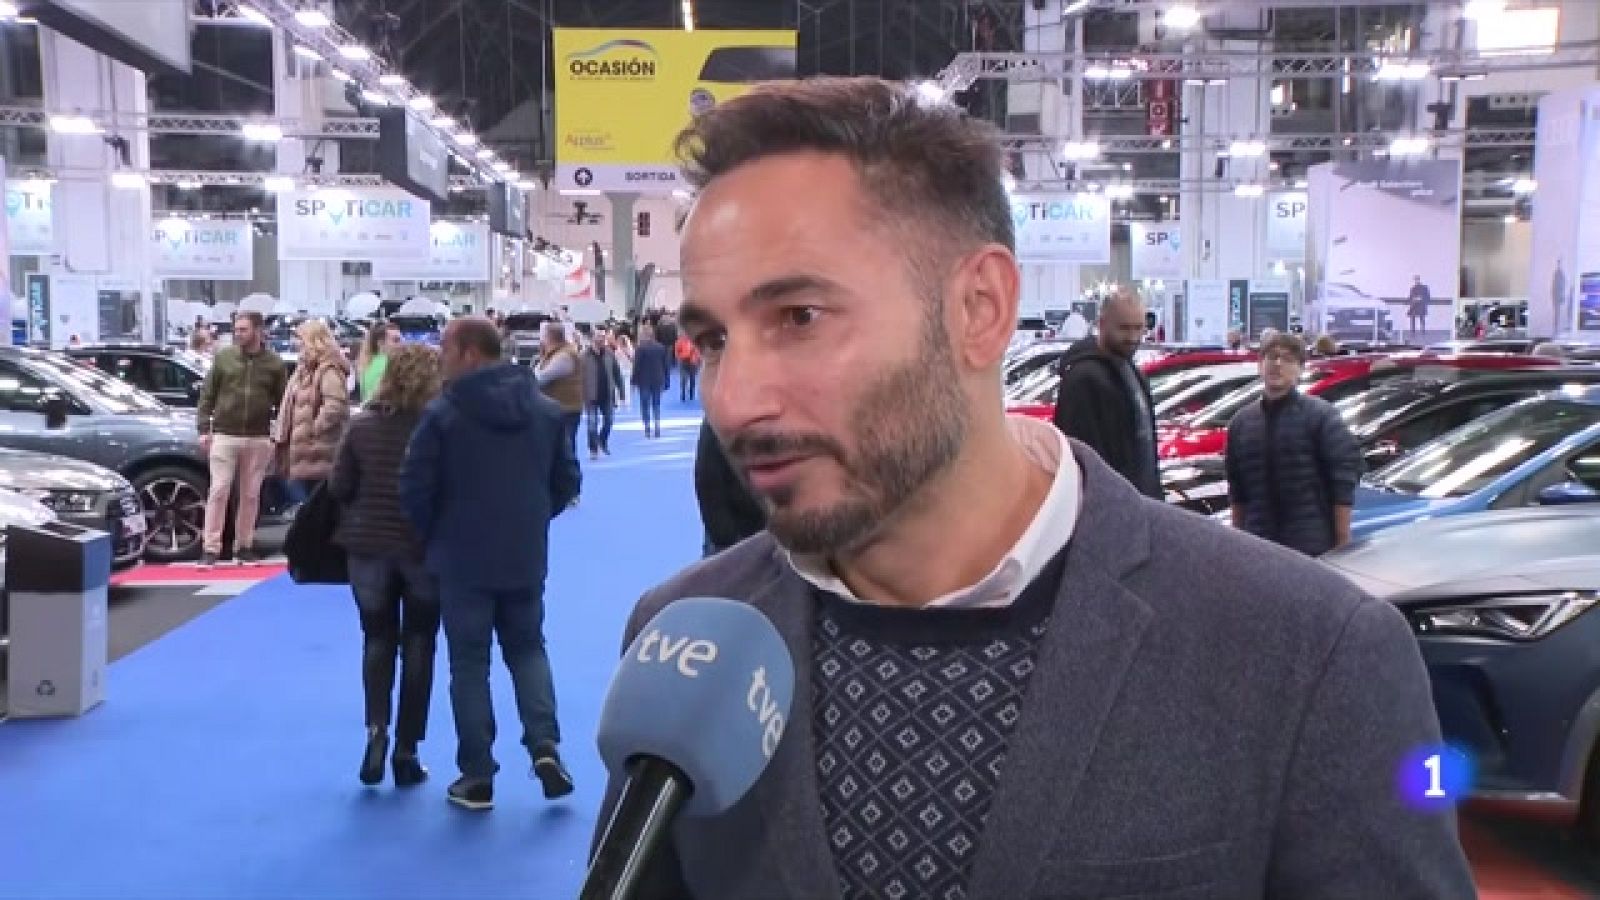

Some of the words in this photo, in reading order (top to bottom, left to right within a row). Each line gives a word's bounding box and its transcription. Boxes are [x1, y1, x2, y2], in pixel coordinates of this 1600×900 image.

[570, 57, 656, 76] OCASIÓN
[626, 171, 676, 182] SORTIDA
[637, 628, 719, 677] tve
[747, 664, 786, 760] tve
